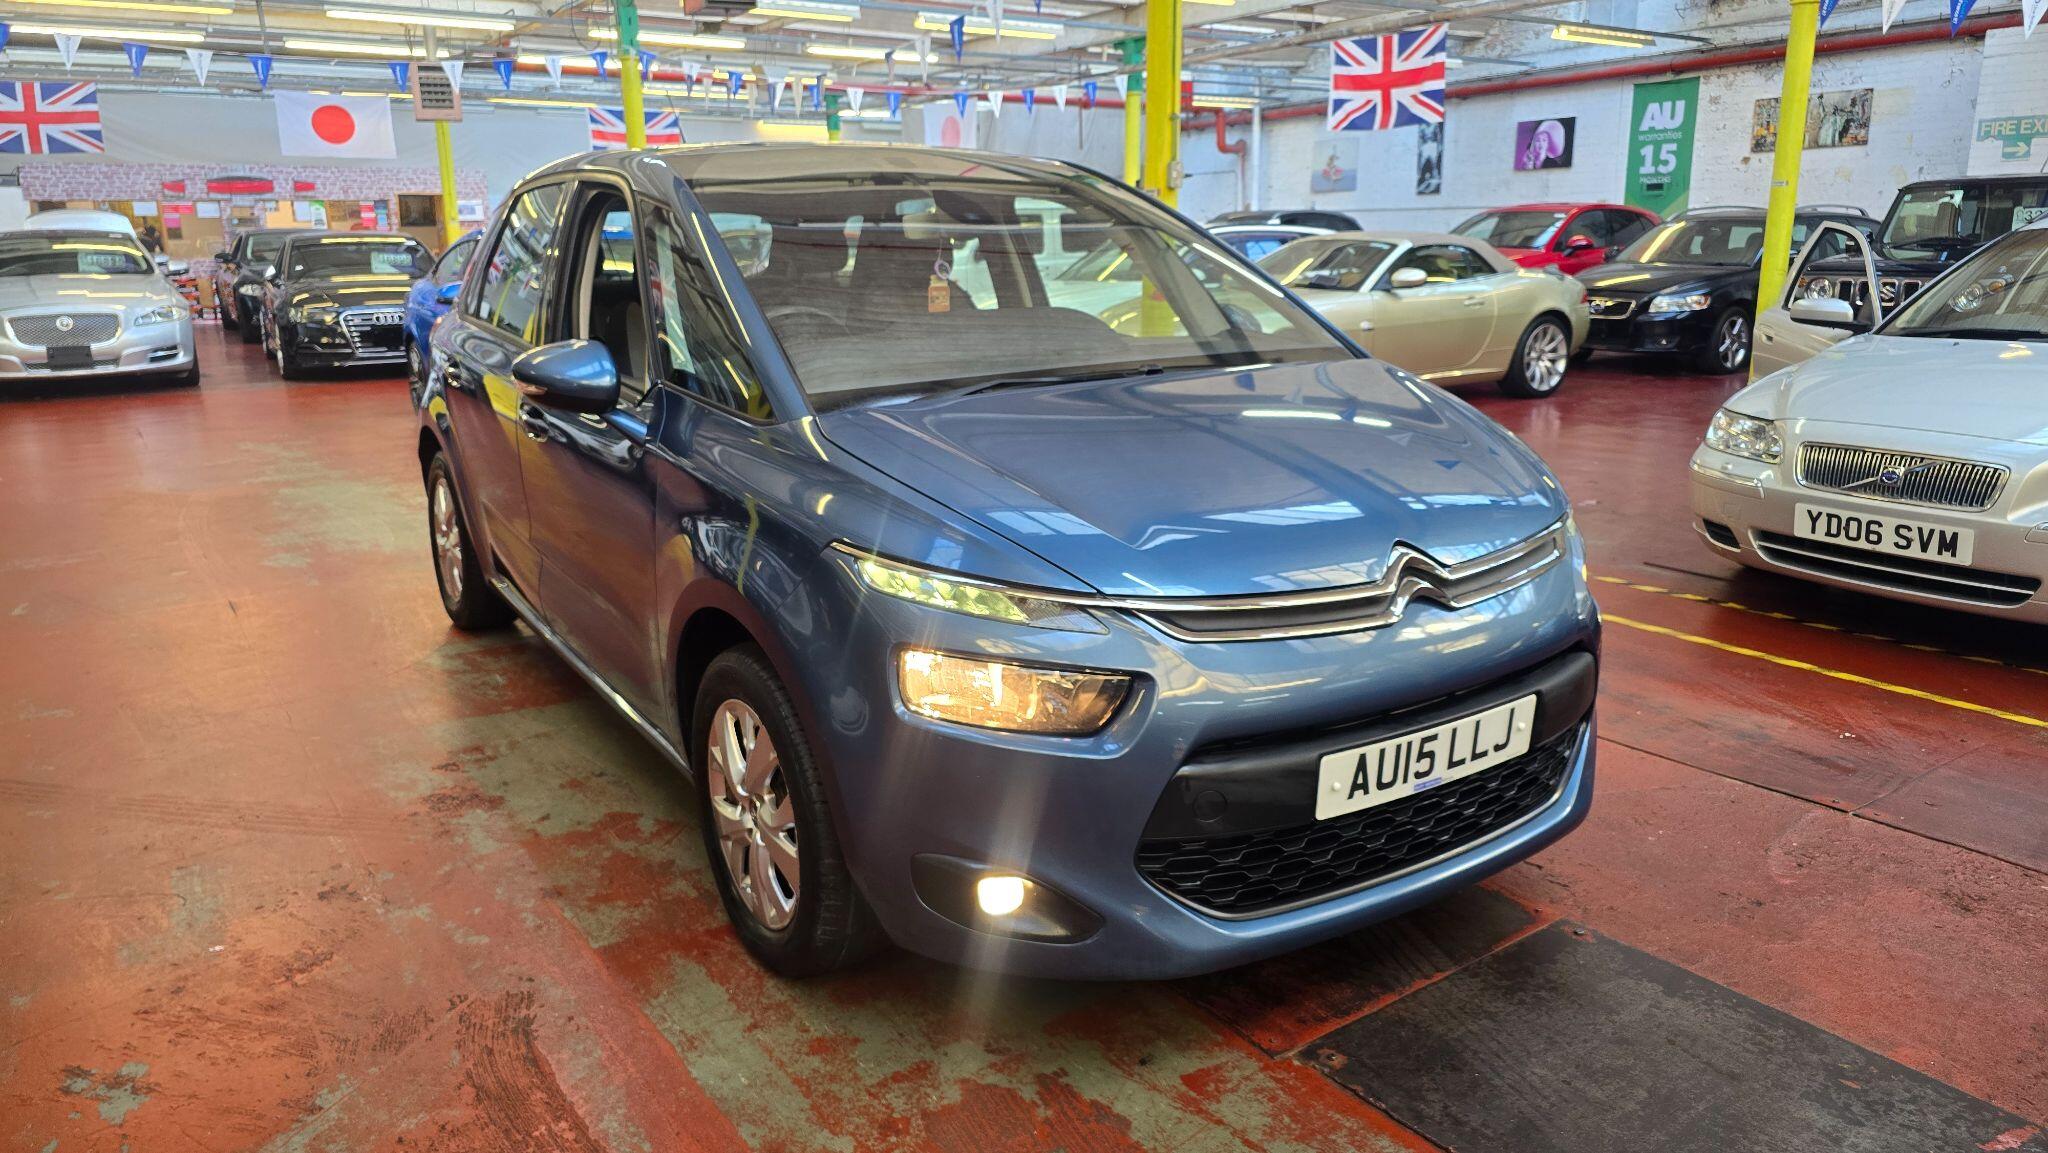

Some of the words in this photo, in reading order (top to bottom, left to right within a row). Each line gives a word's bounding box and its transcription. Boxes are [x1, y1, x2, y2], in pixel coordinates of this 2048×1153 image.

[1639, 100, 1685, 131] AU
[1981, 120, 2017, 137] FIRE
[1639, 143, 1677, 174] 15
[1807, 509, 1883, 546] YD06
[1893, 524, 1959, 558] SVM
[1347, 733, 1438, 800] AU15
[1447, 707, 1515, 770] LLJ
